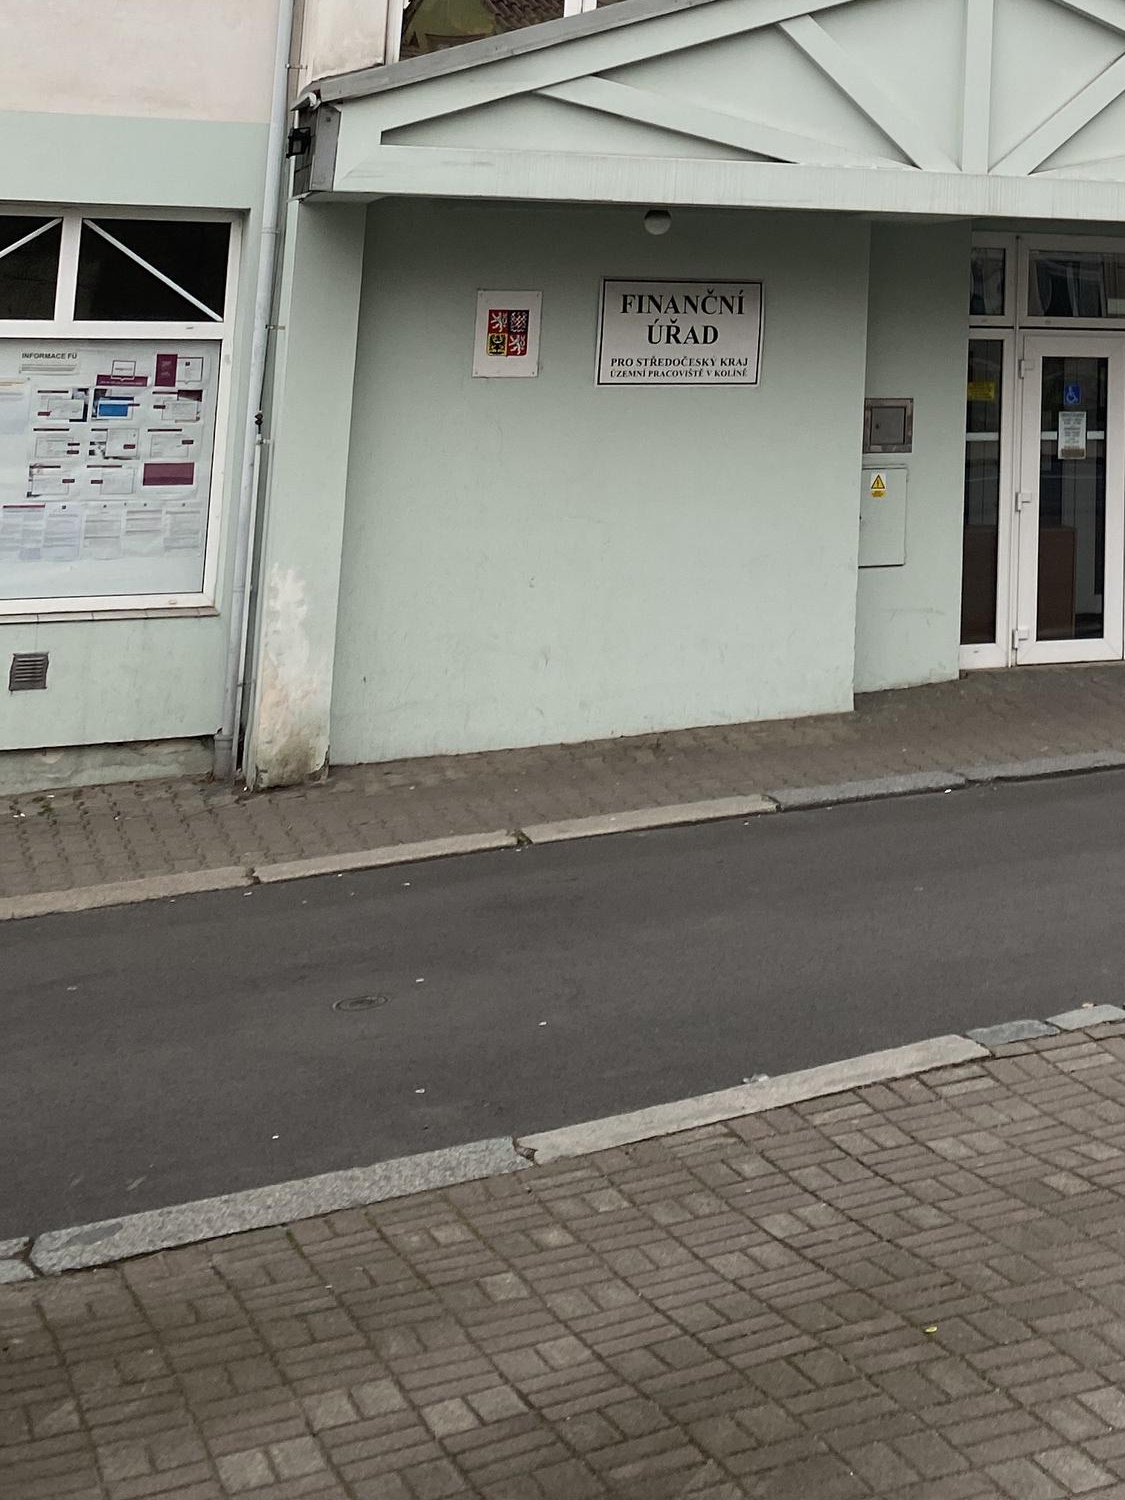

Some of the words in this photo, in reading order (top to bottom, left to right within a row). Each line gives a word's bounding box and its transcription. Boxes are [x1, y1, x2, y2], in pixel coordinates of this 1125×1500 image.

[620, 288, 745, 315] FINANČNÍ
[647, 318, 719, 345] ÚŘAD
[21, 352, 66, 360] INFORMACE
[610, 357, 634, 367] PRO
[635, 355, 717, 367] STŘEDOČESKÝ
[720, 357, 748, 367] KRAJ
[610, 368, 646, 378] ÚZEMNÍ
[648, 368, 703, 378] PRACOVIŠTĚ
[706, 369, 712, 378] V
[714, 367, 748, 378] KOLÍNĚ
